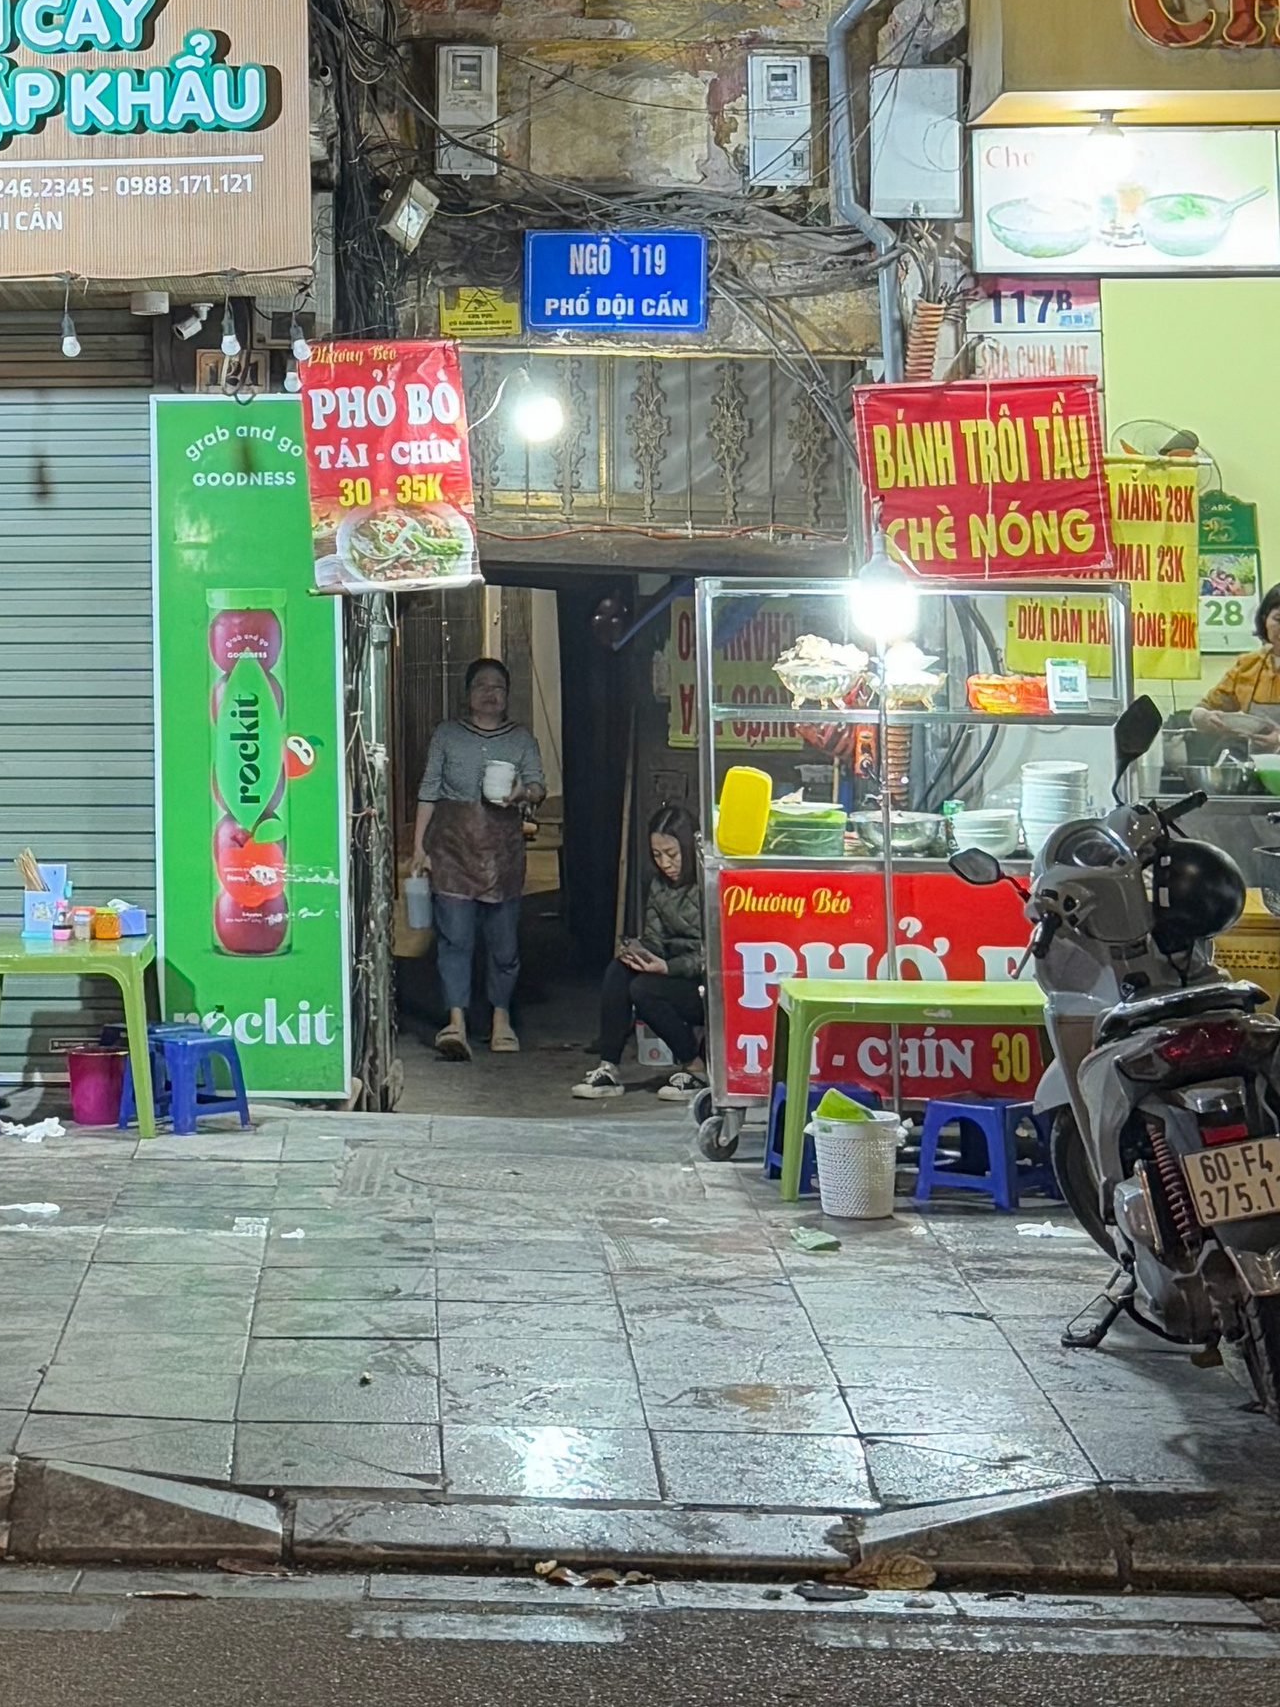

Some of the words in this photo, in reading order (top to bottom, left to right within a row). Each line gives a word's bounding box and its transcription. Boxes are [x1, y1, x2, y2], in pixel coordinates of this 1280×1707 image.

[68, 32, 262, 128] KHẨU
[115, 172, 254, 197] 0988.171.121
[15, 202, 64, 232] CẤN
[570, 237, 612, 276] NGÕ
[630, 243, 667, 276] 119
[544, 286, 590, 316] PHỐ
[596, 292, 635, 320] ĐỘI
[641, 290, 689, 317] CẤN
[308, 369, 397, 430] PHỞ
[405, 367, 461, 425] BÒ
[186, 425, 230, 462] grab
[236, 425, 276, 442] and
[277, 436, 303, 457] go
[314, 437, 369, 470] TÁI
[391, 432, 462, 465] CHÍN
[872, 408, 957, 489] BÁNH
[960, 403, 1030, 484] TRÔI
[1033, 392, 1091, 481] TẦU
[192, 471, 296, 487] GOODNESS
[338, 477, 372, 507] 30
[396, 473, 444, 504] 35K
[1165, 484, 1195, 523] 28K
[885, 504, 958, 562] CHÈ
[969, 500, 1095, 559] NÓNG
[1156, 544, 1186, 583] 23K
[1204, 600, 1244, 627] 28
[230, 692, 261, 804] rockit
[723, 885, 806, 918] Phương
[811, 886, 851, 914] Béo
[856, 1026, 975, 1080] CHÍN
[991, 1032, 1030, 1084] 30
[1199, 1142, 1273, 1185] 60-F4
